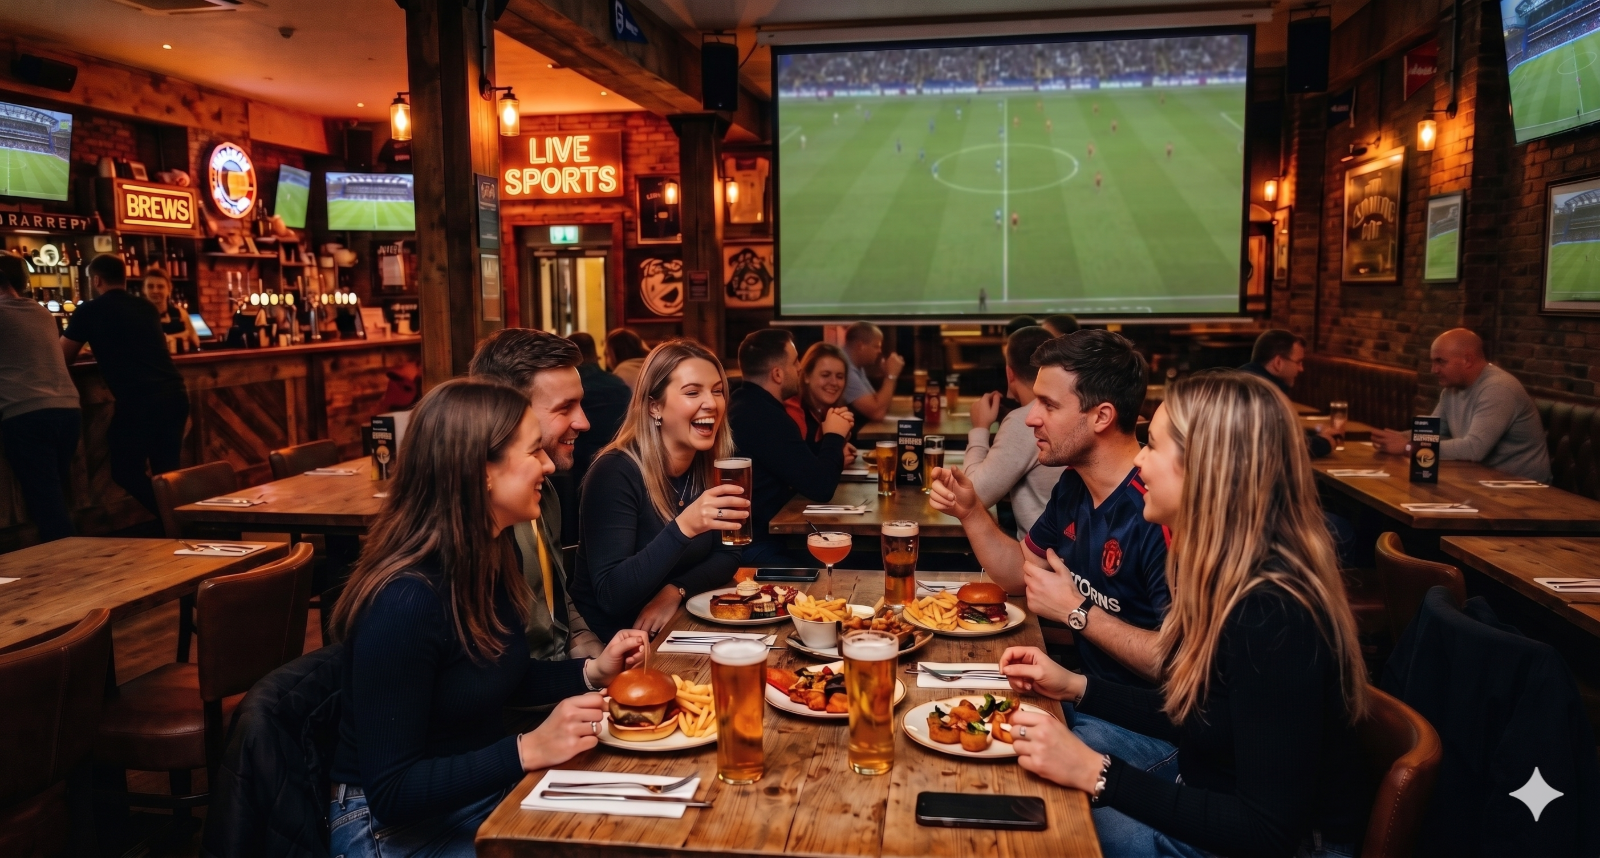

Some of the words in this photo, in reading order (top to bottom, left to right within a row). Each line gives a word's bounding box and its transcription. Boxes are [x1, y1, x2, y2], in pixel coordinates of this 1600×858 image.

[529, 135, 590, 164] LIVE
[504, 165, 617, 196] SPORTS
[126, 193, 190, 222] BREWS
